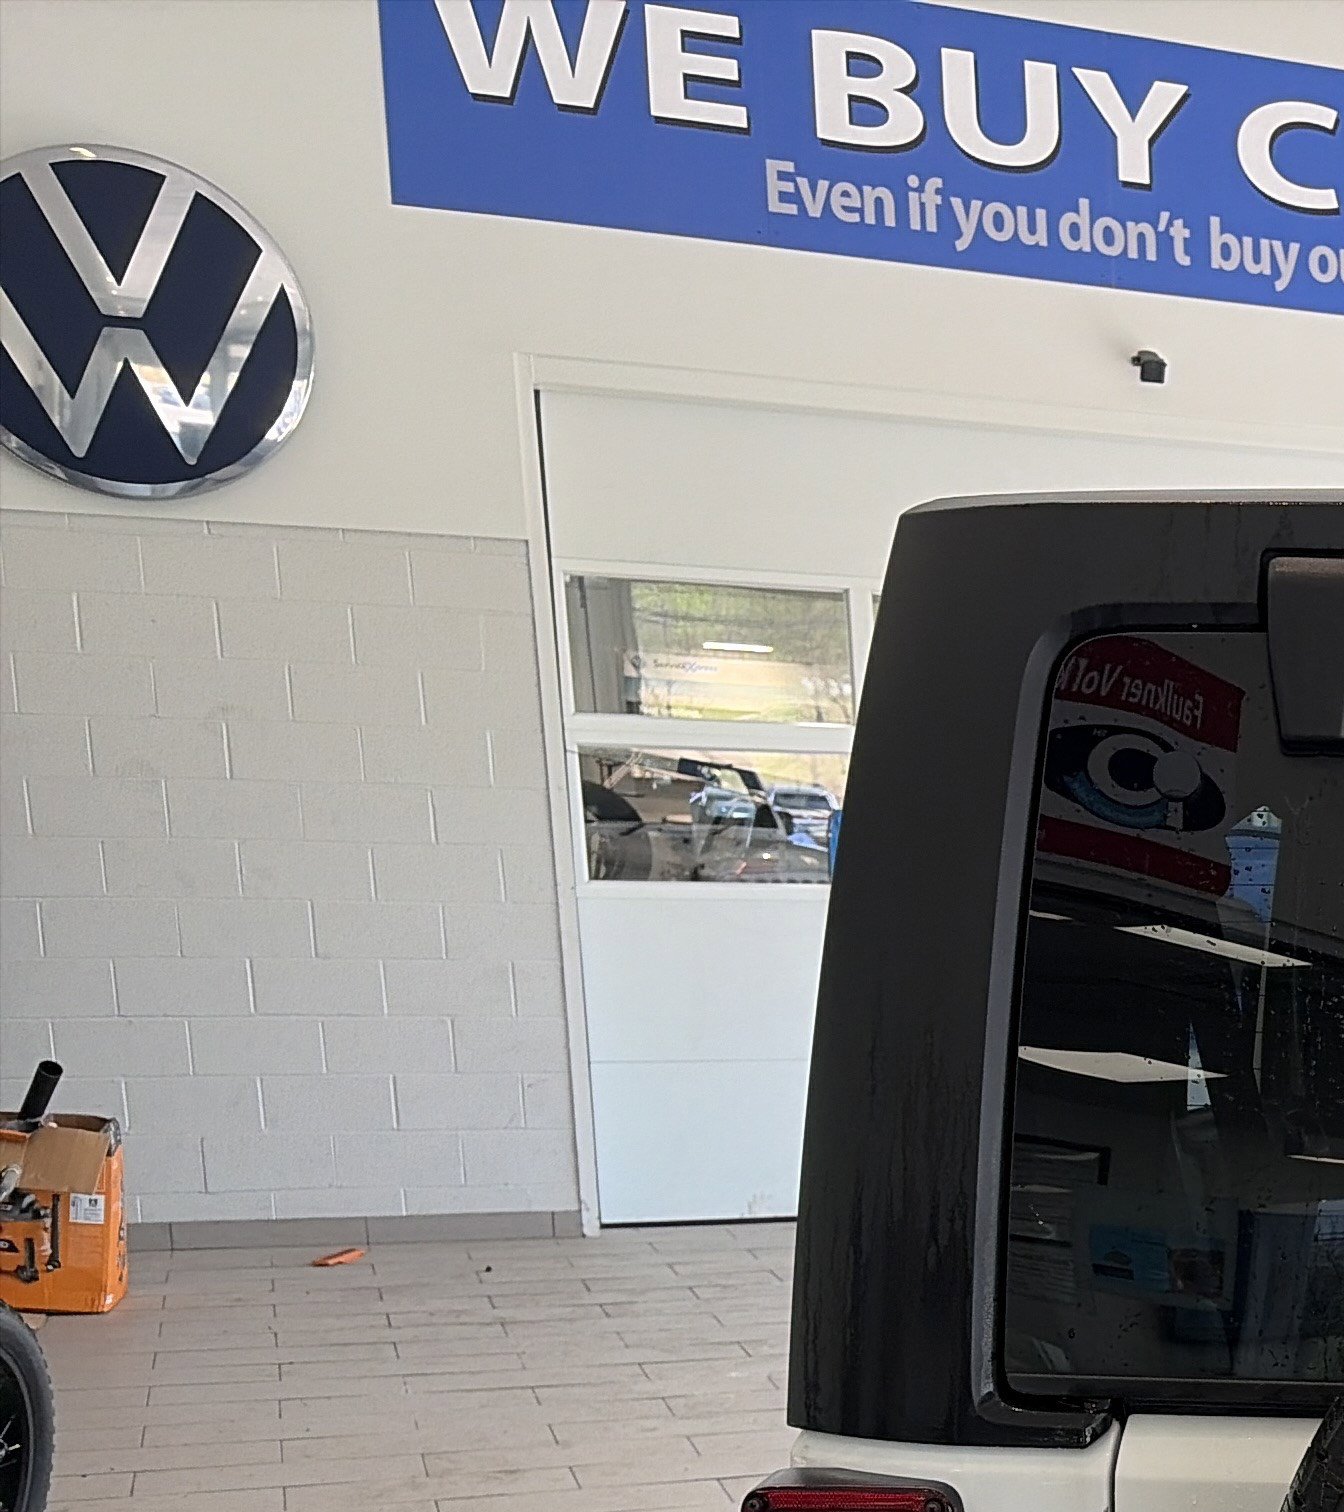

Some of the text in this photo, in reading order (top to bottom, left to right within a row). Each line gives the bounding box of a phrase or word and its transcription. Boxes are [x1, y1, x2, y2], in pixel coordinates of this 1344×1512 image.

[435, 0, 750, 135] WE
[811, 29, 1190, 191] BUY
[765, 158, 896, 228] Even
[907, 175, 944, 233] if
[950, 196, 1048, 252] you
[1058, 198, 1191, 266] don't
[1210, 216, 1300, 291] buy
